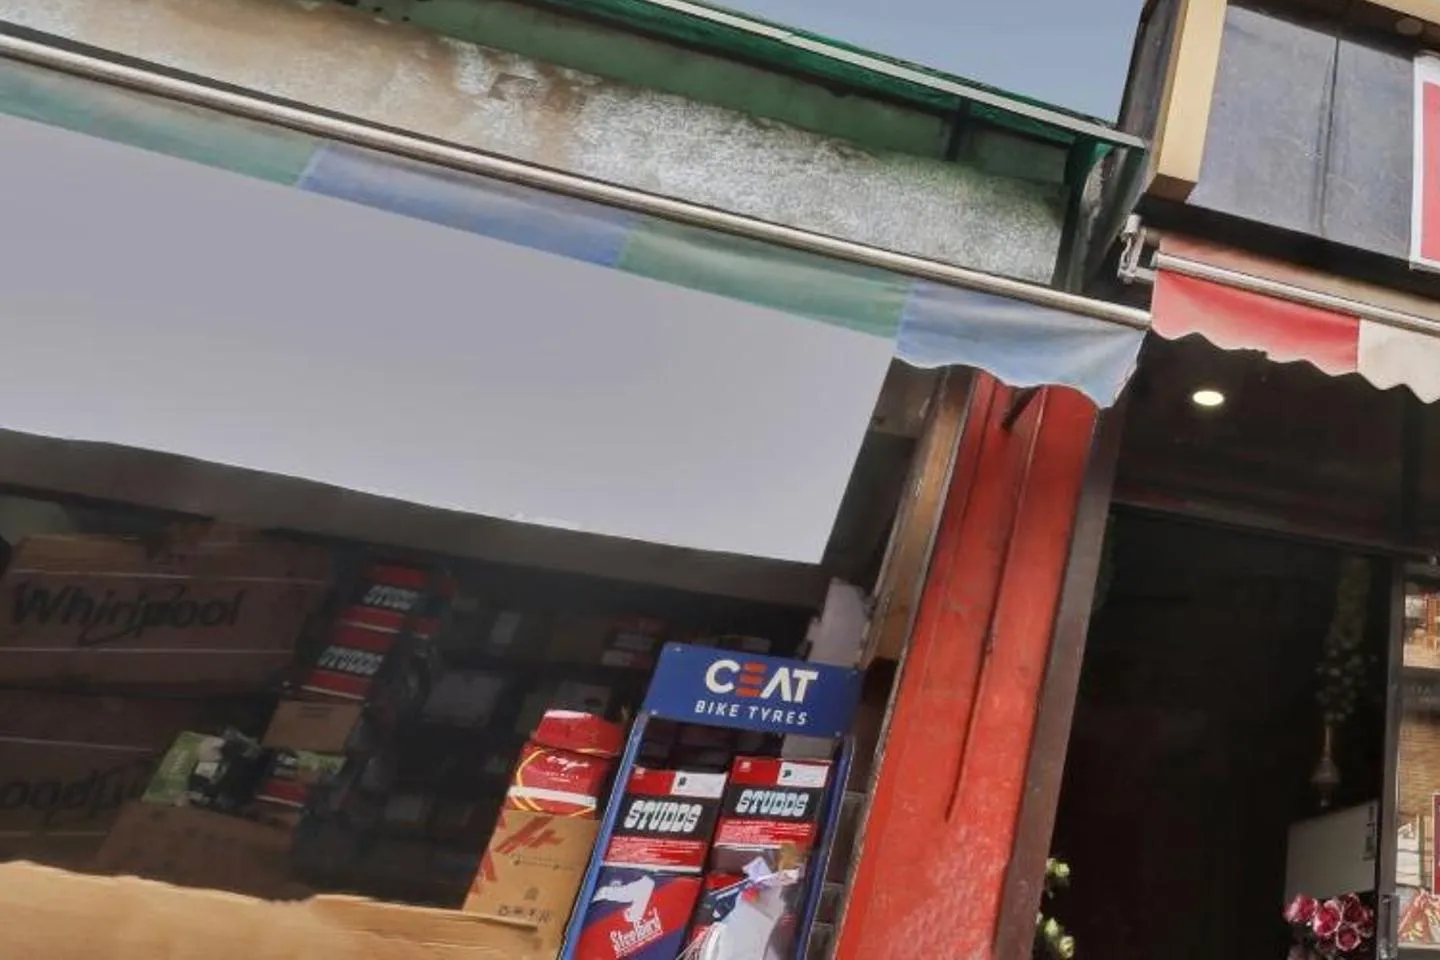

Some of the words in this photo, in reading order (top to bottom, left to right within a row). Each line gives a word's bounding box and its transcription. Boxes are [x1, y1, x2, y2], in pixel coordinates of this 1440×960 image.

[11, 581, 247, 644] Whirlpool
[705, 659, 819, 704] CEAT
[694, 699, 739, 718] BIKE
[748, 706, 809, 726] TYRES
[624, 800, 702, 833] STUDDS
[735, 789, 809, 818] STUDDS
